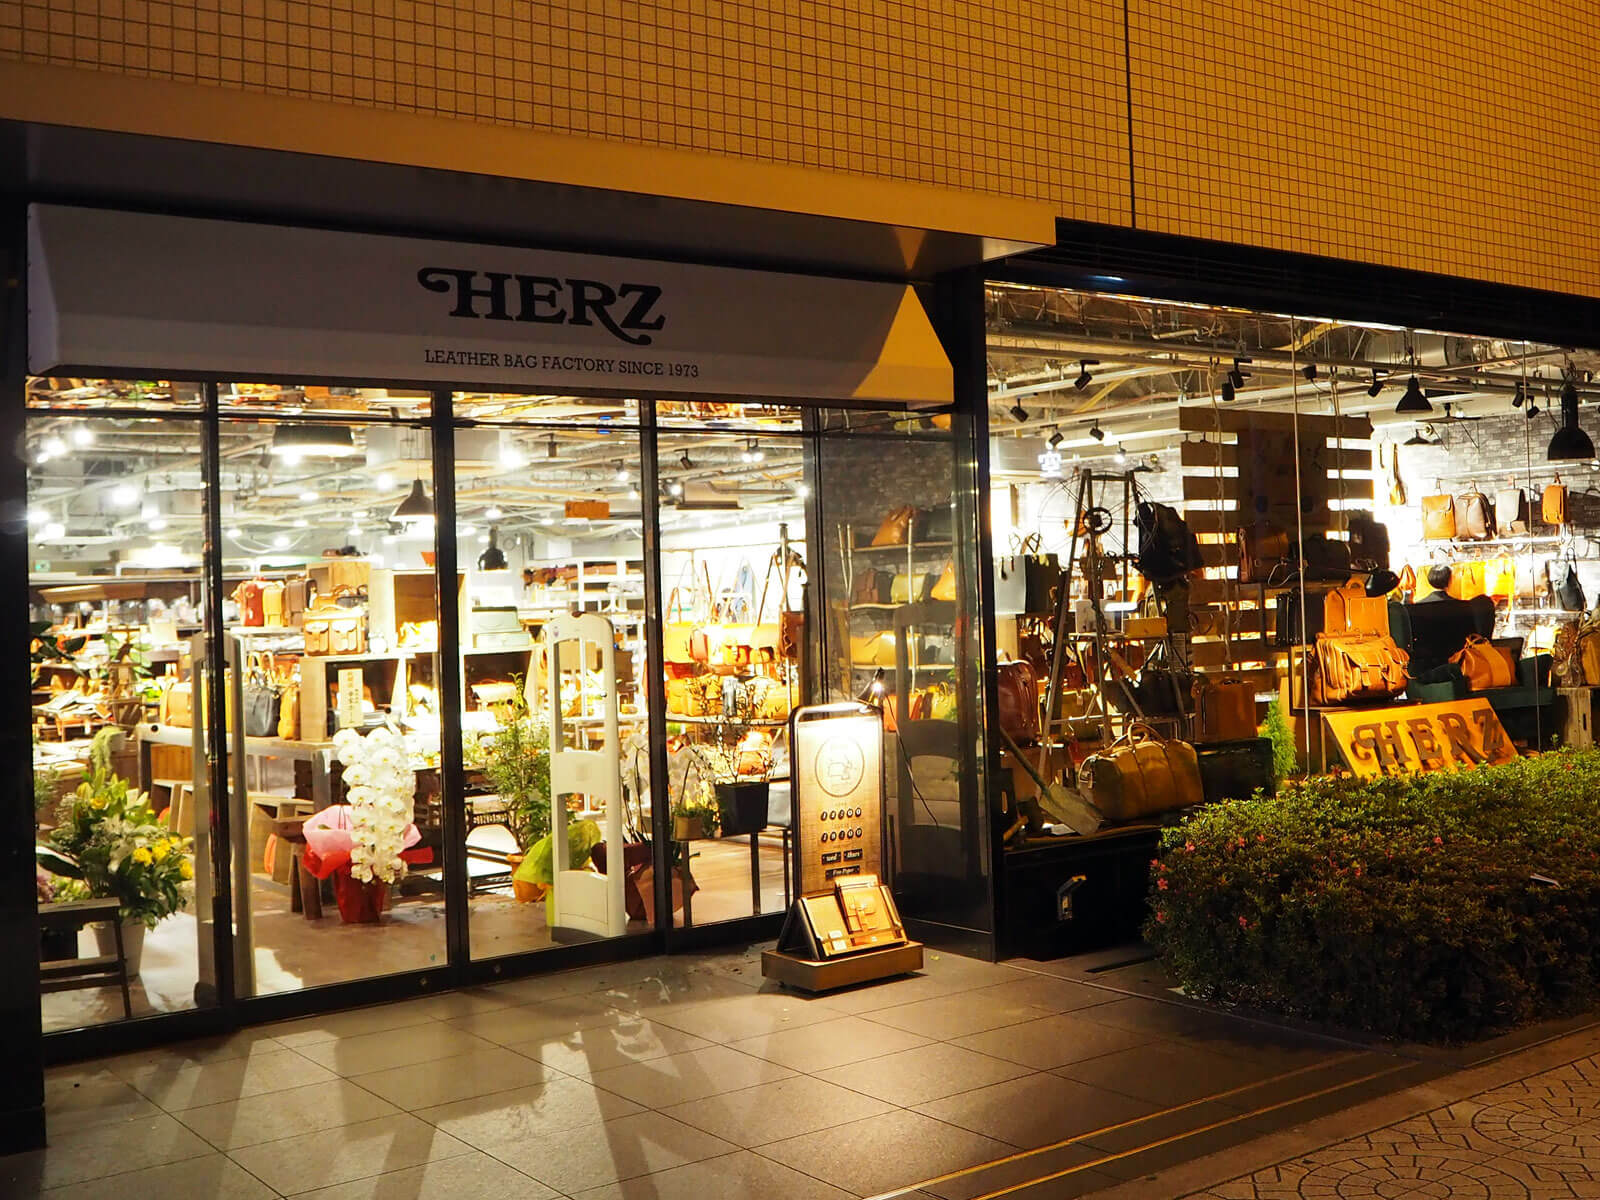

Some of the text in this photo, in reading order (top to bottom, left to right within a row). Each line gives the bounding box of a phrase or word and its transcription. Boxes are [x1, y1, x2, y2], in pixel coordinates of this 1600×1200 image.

[417, 267, 666, 345] HERZ
[425, 350, 699, 377] LEATHER BAG FACTORY SINCE 1973
[1353, 708, 1504, 766] HERZ
